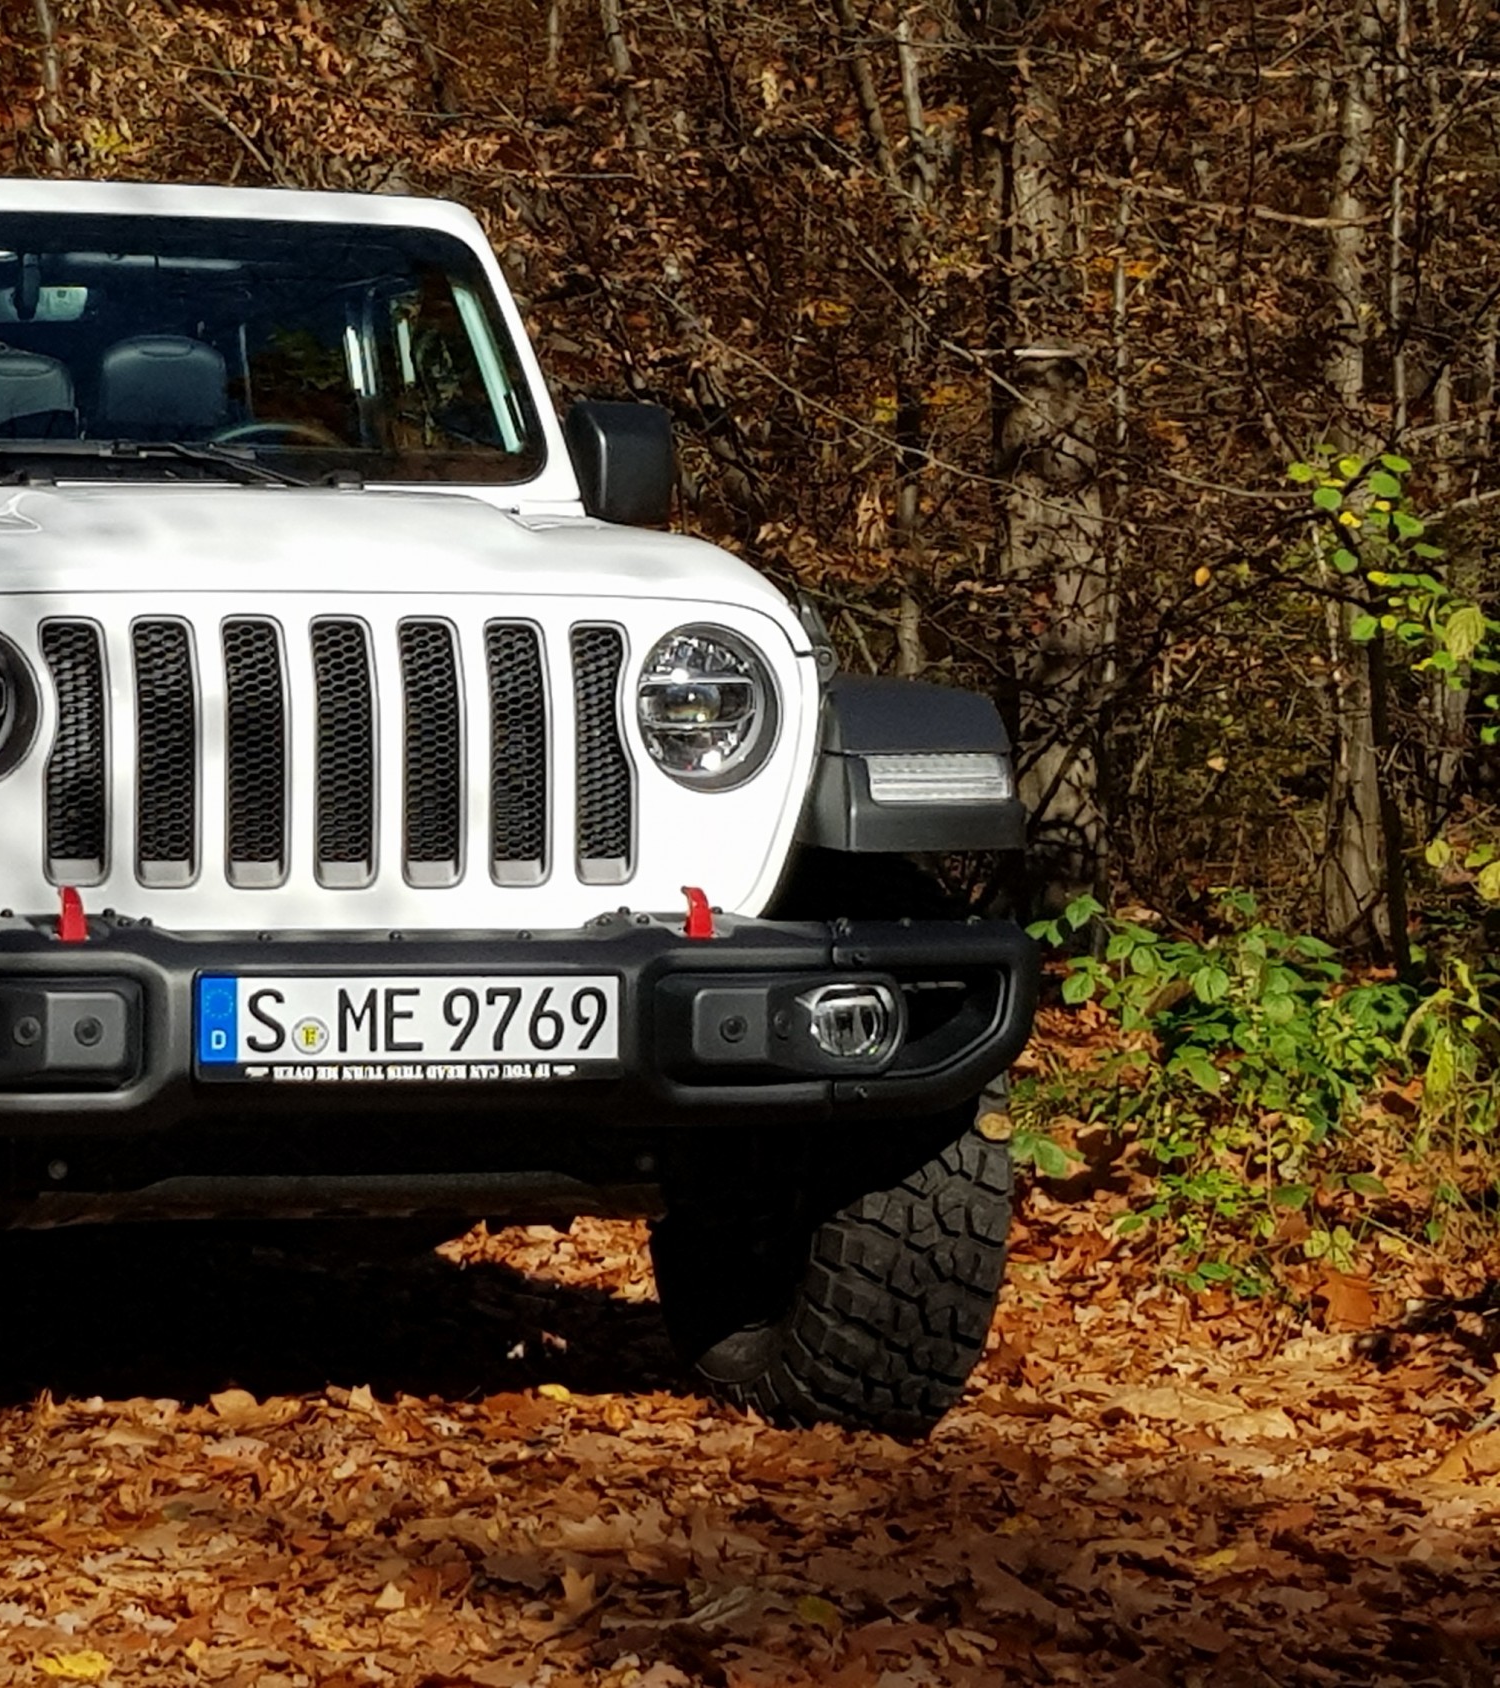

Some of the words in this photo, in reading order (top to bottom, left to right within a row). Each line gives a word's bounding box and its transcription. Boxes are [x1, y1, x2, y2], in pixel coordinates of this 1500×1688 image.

[246, 988, 286, 1053] S
[337, 988, 424, 1053] ME
[442, 986, 609, 1052] 9769
[211, 1031, 227, 1050] D
[273, 1066, 314, 1081] OVER
[316, 1066, 339, 1080] ME
[342, 1065, 385, 1080] TURN
[386, 1065, 424, 1079] THIS
[426, 1064, 467, 1079] READ
[470, 1064, 500, 1078] CAN
[502, 1064, 532, 1078] YOU
